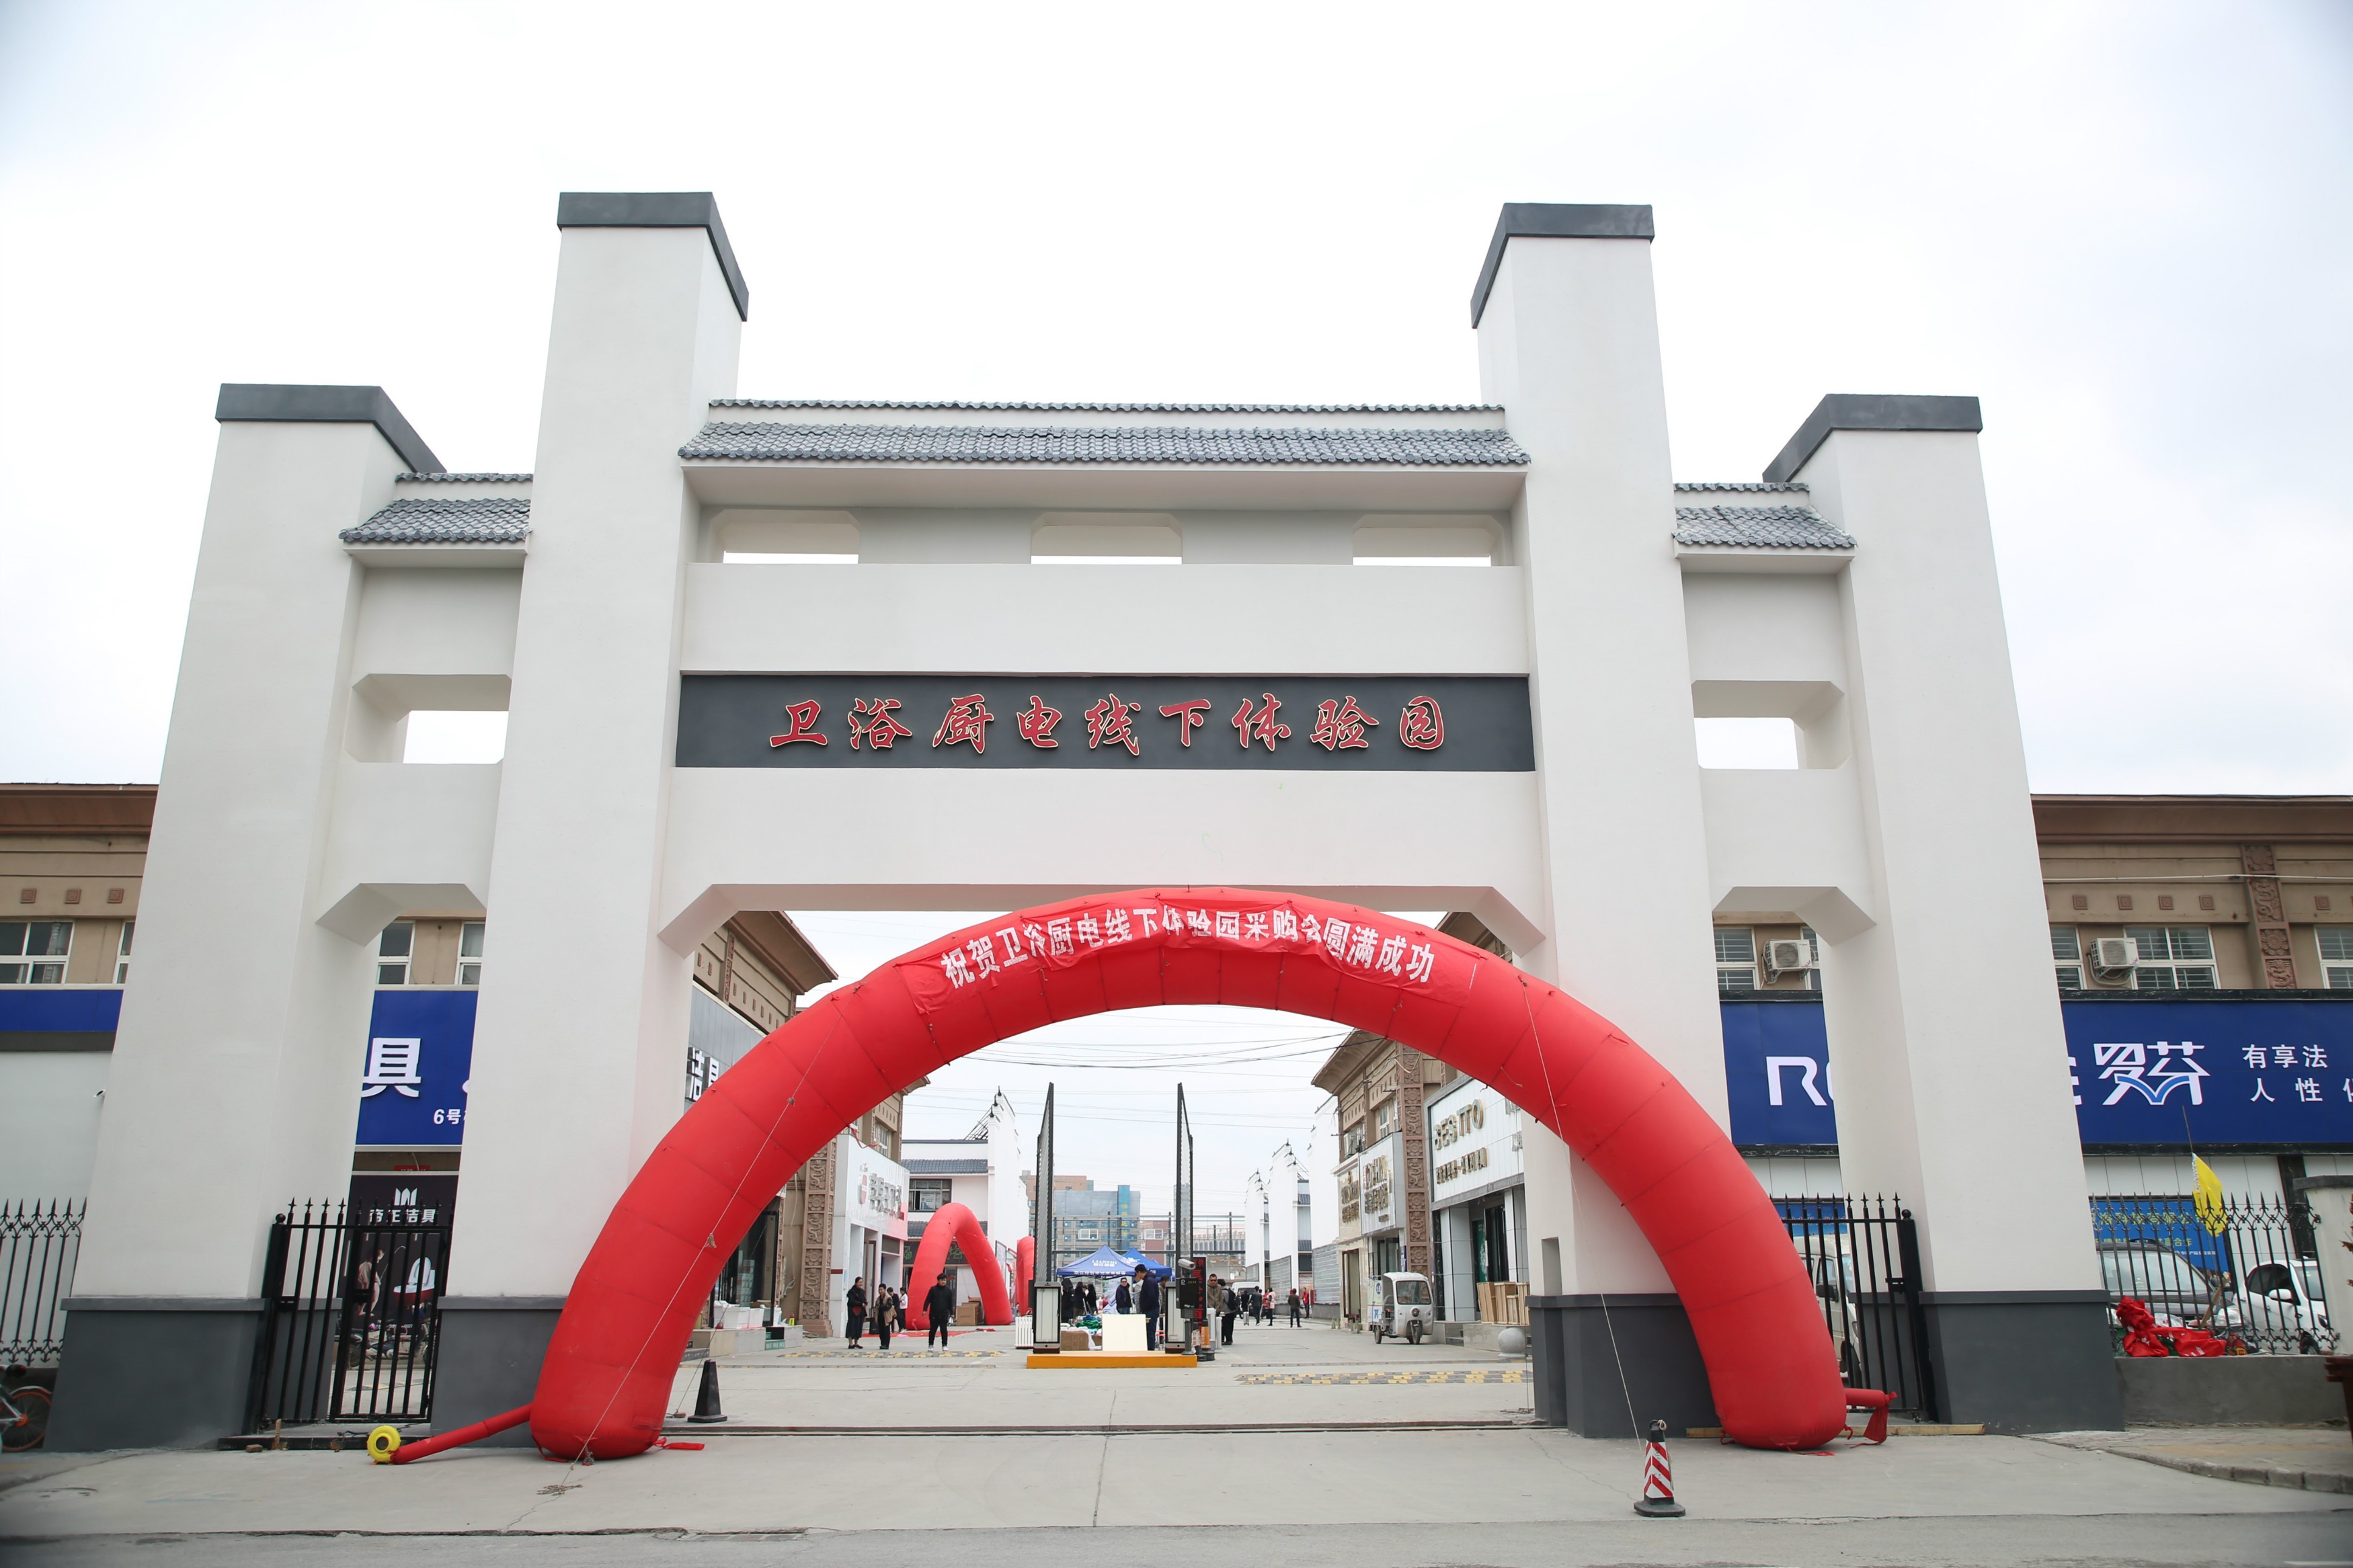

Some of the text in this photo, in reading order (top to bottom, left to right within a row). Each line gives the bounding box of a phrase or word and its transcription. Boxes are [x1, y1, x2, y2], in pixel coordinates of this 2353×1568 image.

[770, 693, 1445, 755] 卫浴厨电线下体验园
[941, 908, 1435, 989] 祝贺卫浴厨电线下体验园采购会圆满成功
[1765, 1056, 1835, 1106] R
[2241, 1044, 2328, 1069] 有享法
[433, 1108, 467, 1125] 6号
